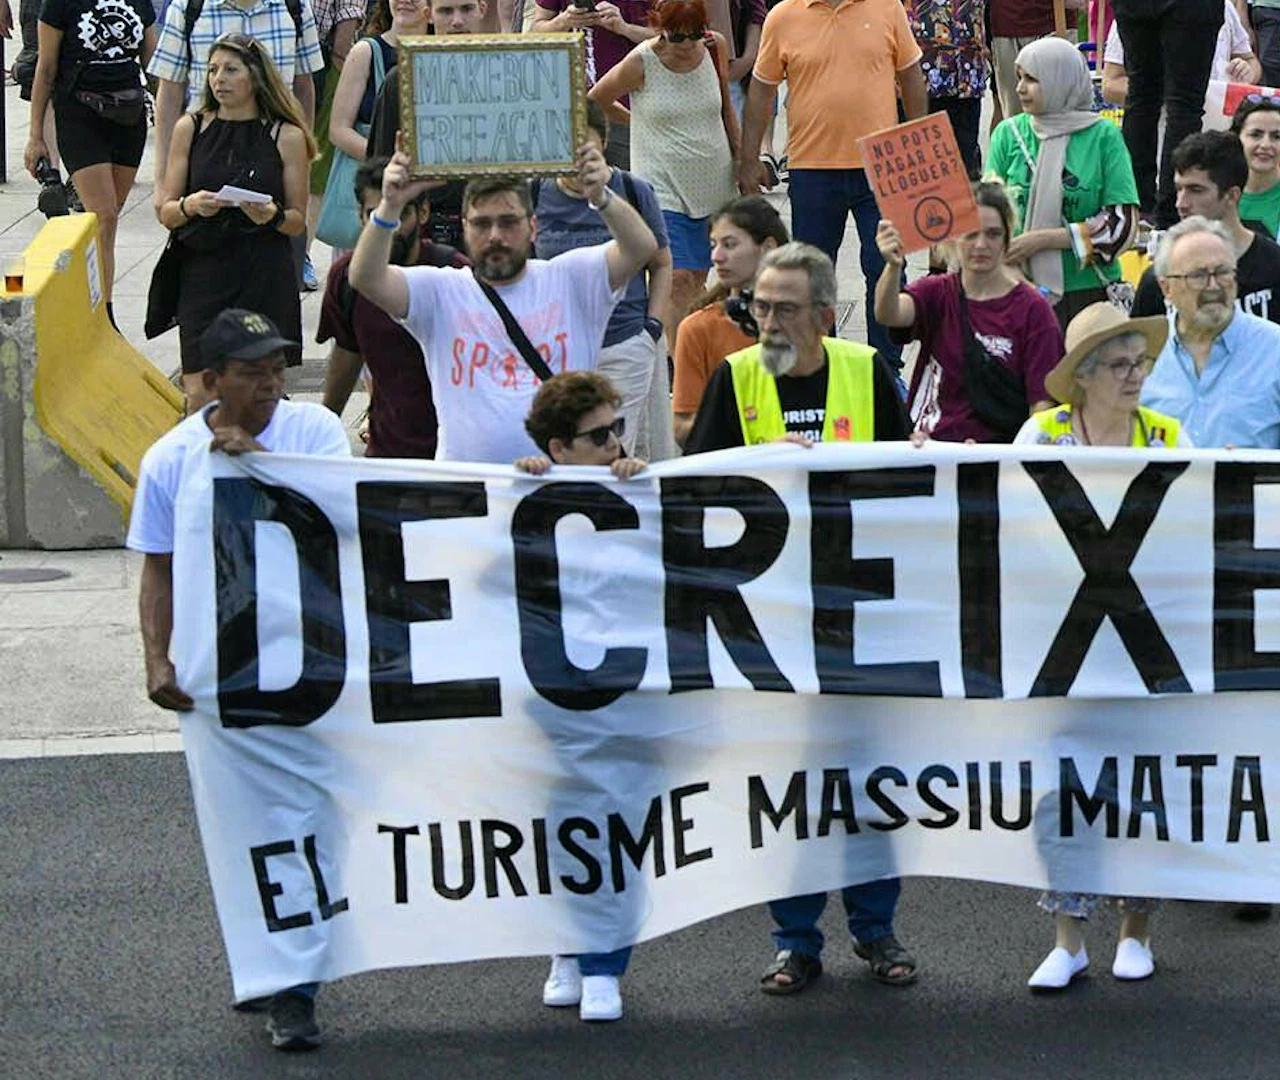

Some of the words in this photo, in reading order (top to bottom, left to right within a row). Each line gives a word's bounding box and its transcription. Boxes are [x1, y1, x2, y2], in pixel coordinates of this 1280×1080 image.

[872, 139, 894, 159] NO
[901, 124, 943, 150] POTS
[874, 150, 926, 180] PAGAR
[932, 142, 954, 160] EL
[877, 158, 960, 198] LLOGUER?
[250, 833, 349, 933] EL
[377, 781, 713, 906] TURISME
[747, 759, 1034, 850] MASSIU
[1058, 754, 1270, 844] MATA
